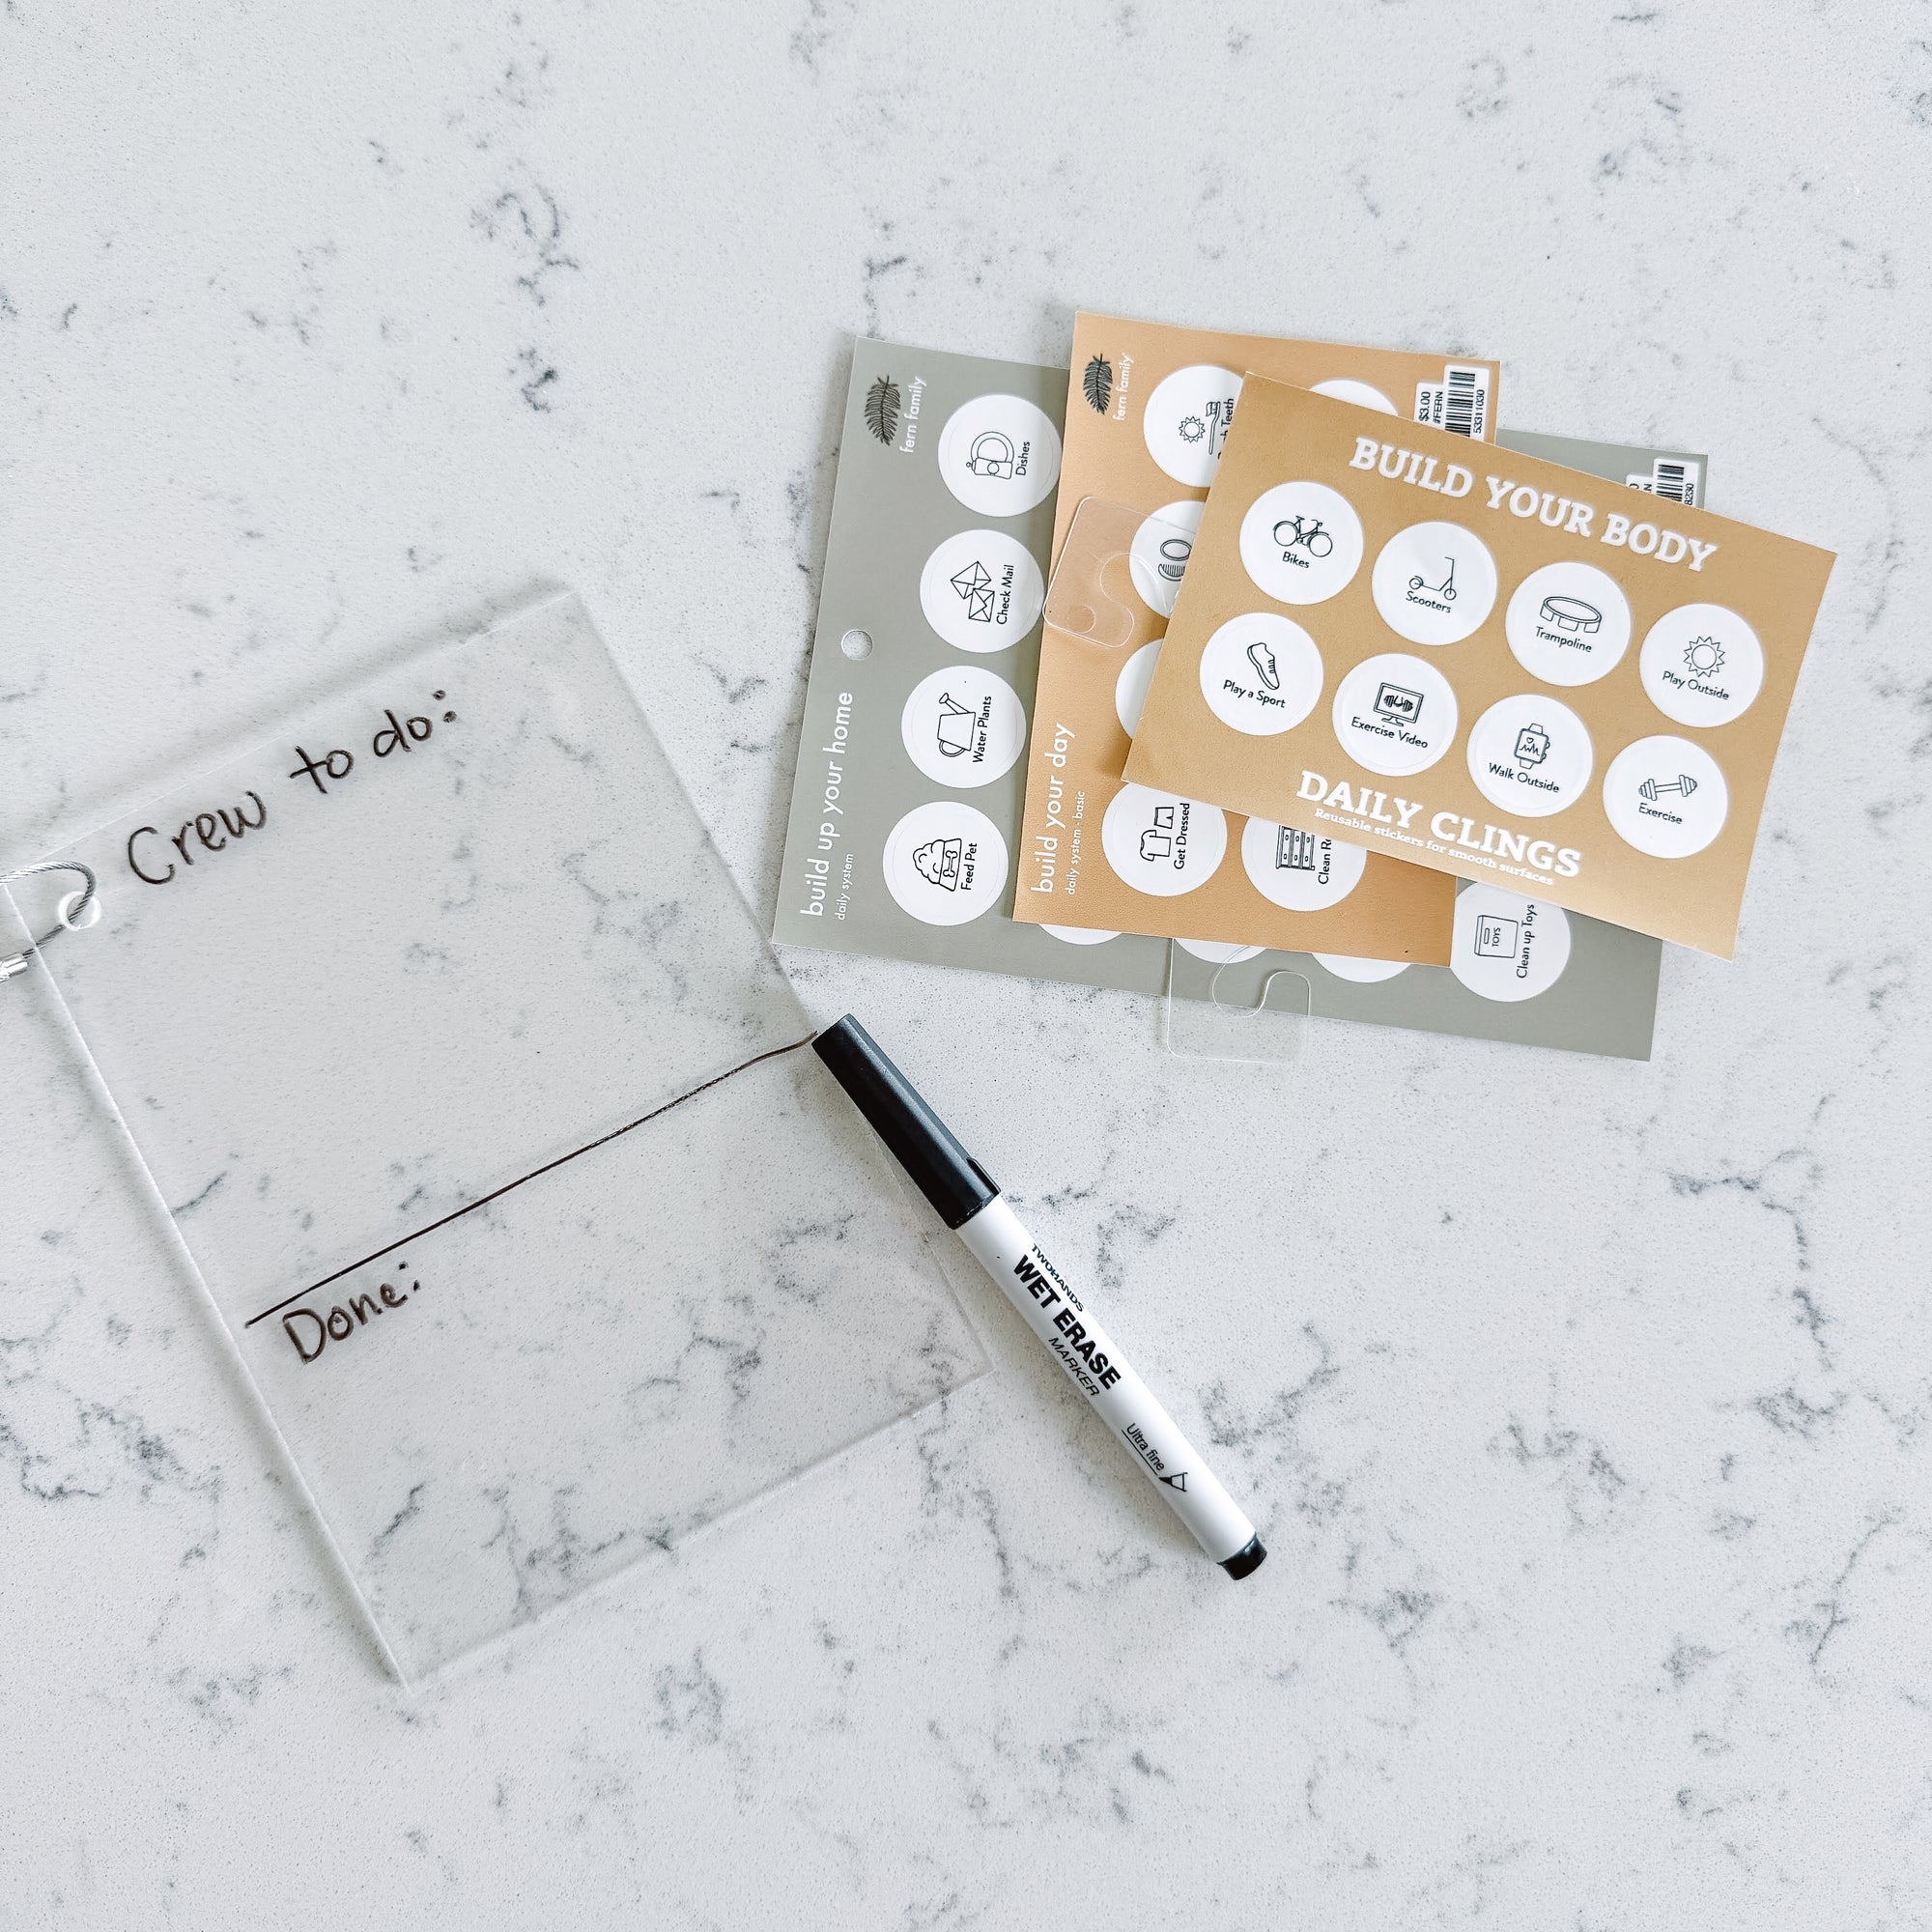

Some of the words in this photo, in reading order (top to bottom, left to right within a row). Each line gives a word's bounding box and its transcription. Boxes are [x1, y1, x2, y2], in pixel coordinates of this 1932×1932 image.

[903, 376, 927, 420] family
[1112, 396, 1127, 421] fern
[1220, 398, 1234, 427] Teeth
[1418, 391, 1431, 421] $3.00
[1433, 391, 1443, 424] #FERN
[1473, 389, 1485, 434] 53311030
[899, 424, 917, 453] fern
[1015, 441, 1031, 476] Dishes
[1349, 437, 1474, 498] BUILD
[1485, 475, 1595, 538] YOUR
[1600, 512, 1718, 573] BODY
[1684, 483, 1694, 505] 8230
[1002, 564, 1014, 588] Mail
[1282, 551, 1311, 570] Bikes
[996, 590, 1011, 625] Check
[1406, 590, 1453, 614] Scooters
[1535, 626, 1593, 653] Trampoline
[1223, 679, 1246, 699] Play
[1247, 689, 1255, 698] a
[1256, 690, 1287, 710] Sport
[1662, 670, 1685, 691] Play
[1687, 678, 1730, 701] Outside
[822, 692, 854, 754] home
[977, 696, 992, 727] Plants
[972, 730, 987, 763] Water
[1043, 723, 1076, 769] day
[1350, 716, 1396, 740] Exercise
[1398, 728, 1429, 750] Video
[128, 790, 268, 885] Crew
[289, 745, 355, 795] to
[372, 689, 458, 758] do:
[822, 761, 844, 815] your
[1489, 762, 1515, 781] Walk
[1517, 772, 1560, 793] Outside
[1045, 775, 1067, 830] your
[1072, 790, 1085, 820] basic
[1637, 802, 1683, 825] Exercise
[817, 822, 841, 851] up
[1176, 803, 1191, 847] Dressed
[1296, 770, 1424, 831] DAILY
[1430, 810, 1581, 877] CLINGS
[964, 842, 978, 859] Pet
[1069, 826, 1080, 866] system
[1173, 848, 1184, 870] Get
[1315, 808, 1372, 834] Reusable
[1374, 824, 1425, 850] stickers
[1426, 838, 1447, 854] for
[1448, 845, 1497, 869] smooth
[1498, 861, 1554, 886] surfaces
[841, 853, 854, 891] system
[960, 861, 975, 891] Feed
[1030, 836, 1058, 894] build
[1064, 867, 1079, 895] daily
[1318, 853, 1331, 885] Clean
[800, 857, 830, 917] build
[834, 892, 851, 921] daily
[1521, 903, 1538, 928] Toys
[1492, 926, 1501, 948] TOYS
[1520, 929, 1535, 943] up
[1516, 944, 1530, 979] Clean
[1031, 1243, 1085, 1312] TWOHANDS
[282, 1260, 421, 1365] Done:
[1013, 1254, 1062, 1309] WET
[1052, 1307, 1122, 1390] ERASE
[1048, 1337, 1100, 1397] MARKER
[1126, 1422, 1149, 1452] Ultra
[1145, 1447, 1165, 1472] fine
